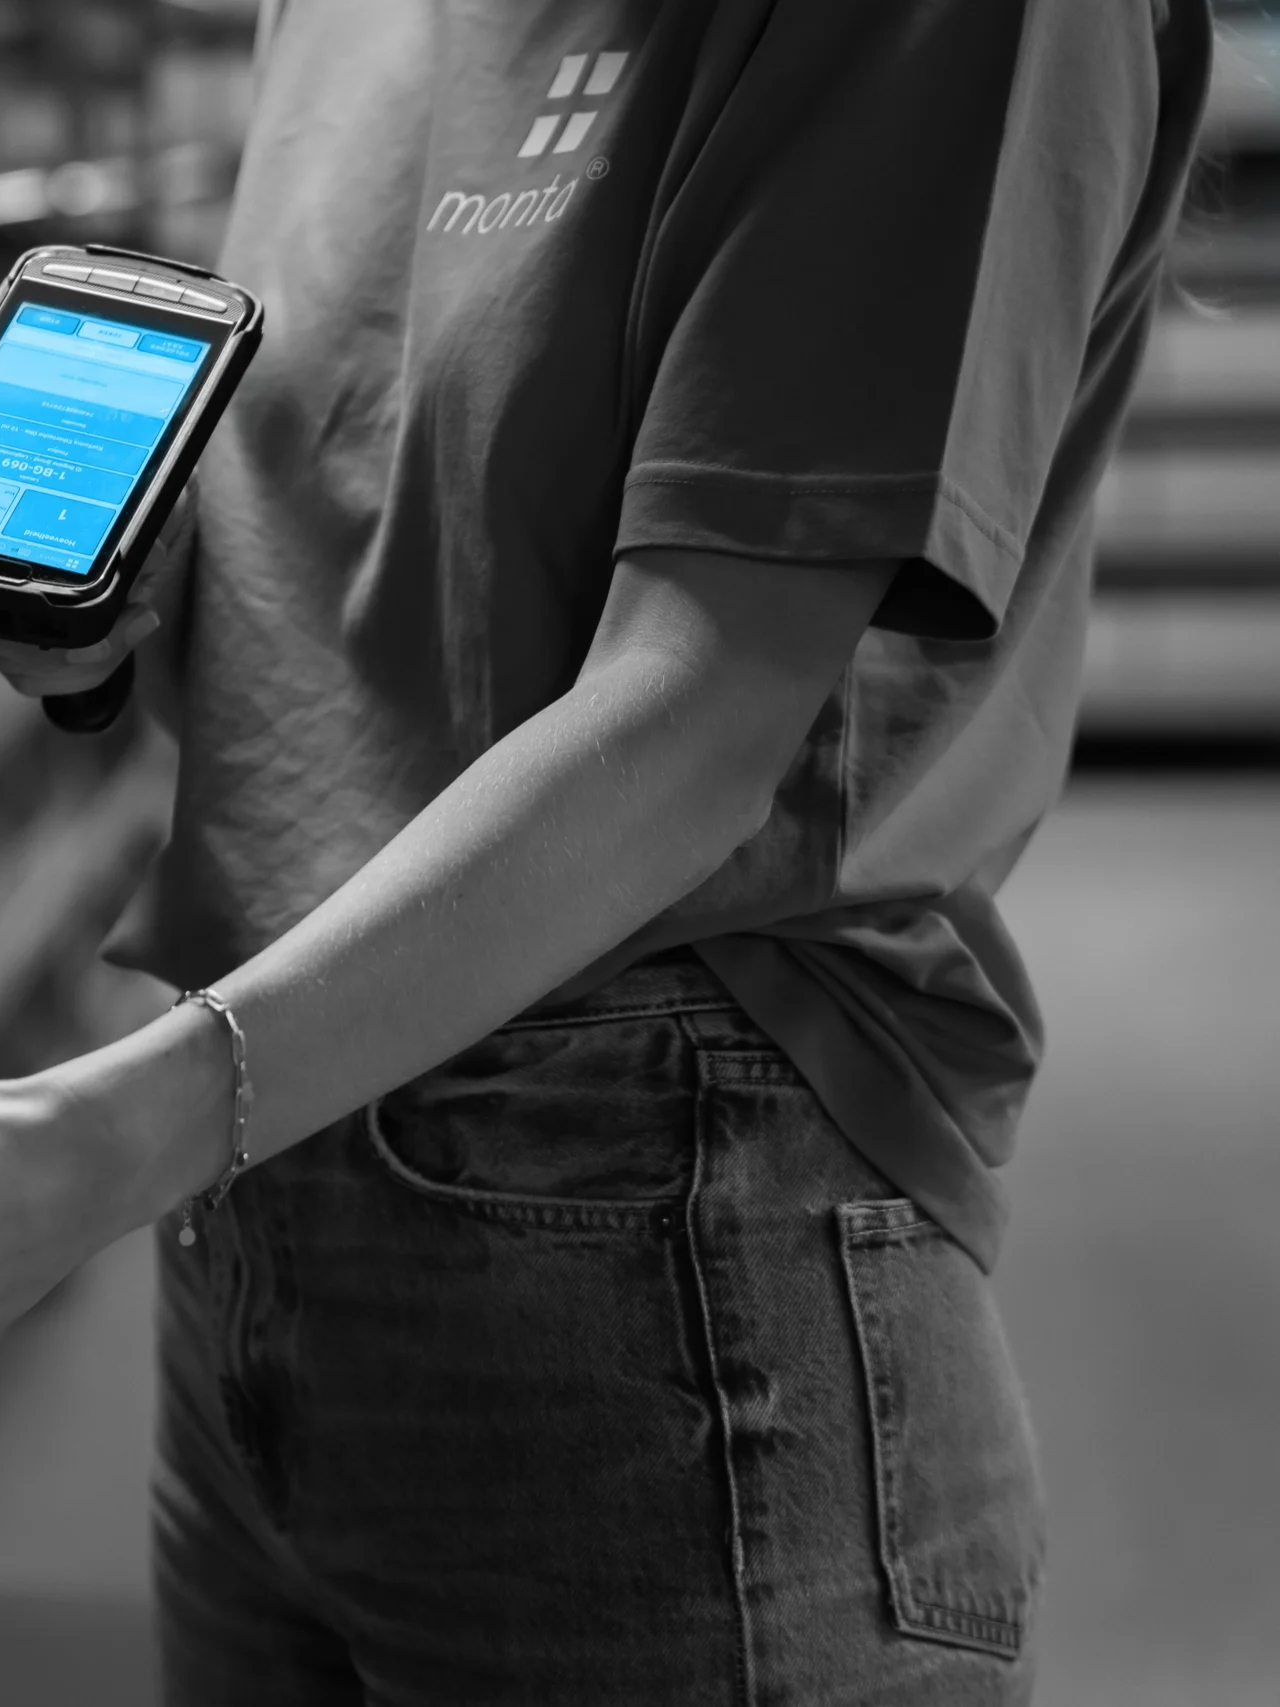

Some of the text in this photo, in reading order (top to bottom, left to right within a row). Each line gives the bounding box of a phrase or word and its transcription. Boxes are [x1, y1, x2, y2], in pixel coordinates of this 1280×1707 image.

[426, 173, 580, 235] monta
[1, 459, 67, 481] 1-BG-069
[58, 508, 68, 521] 1
[24, 530, 75, 548] Hoeveelheid
